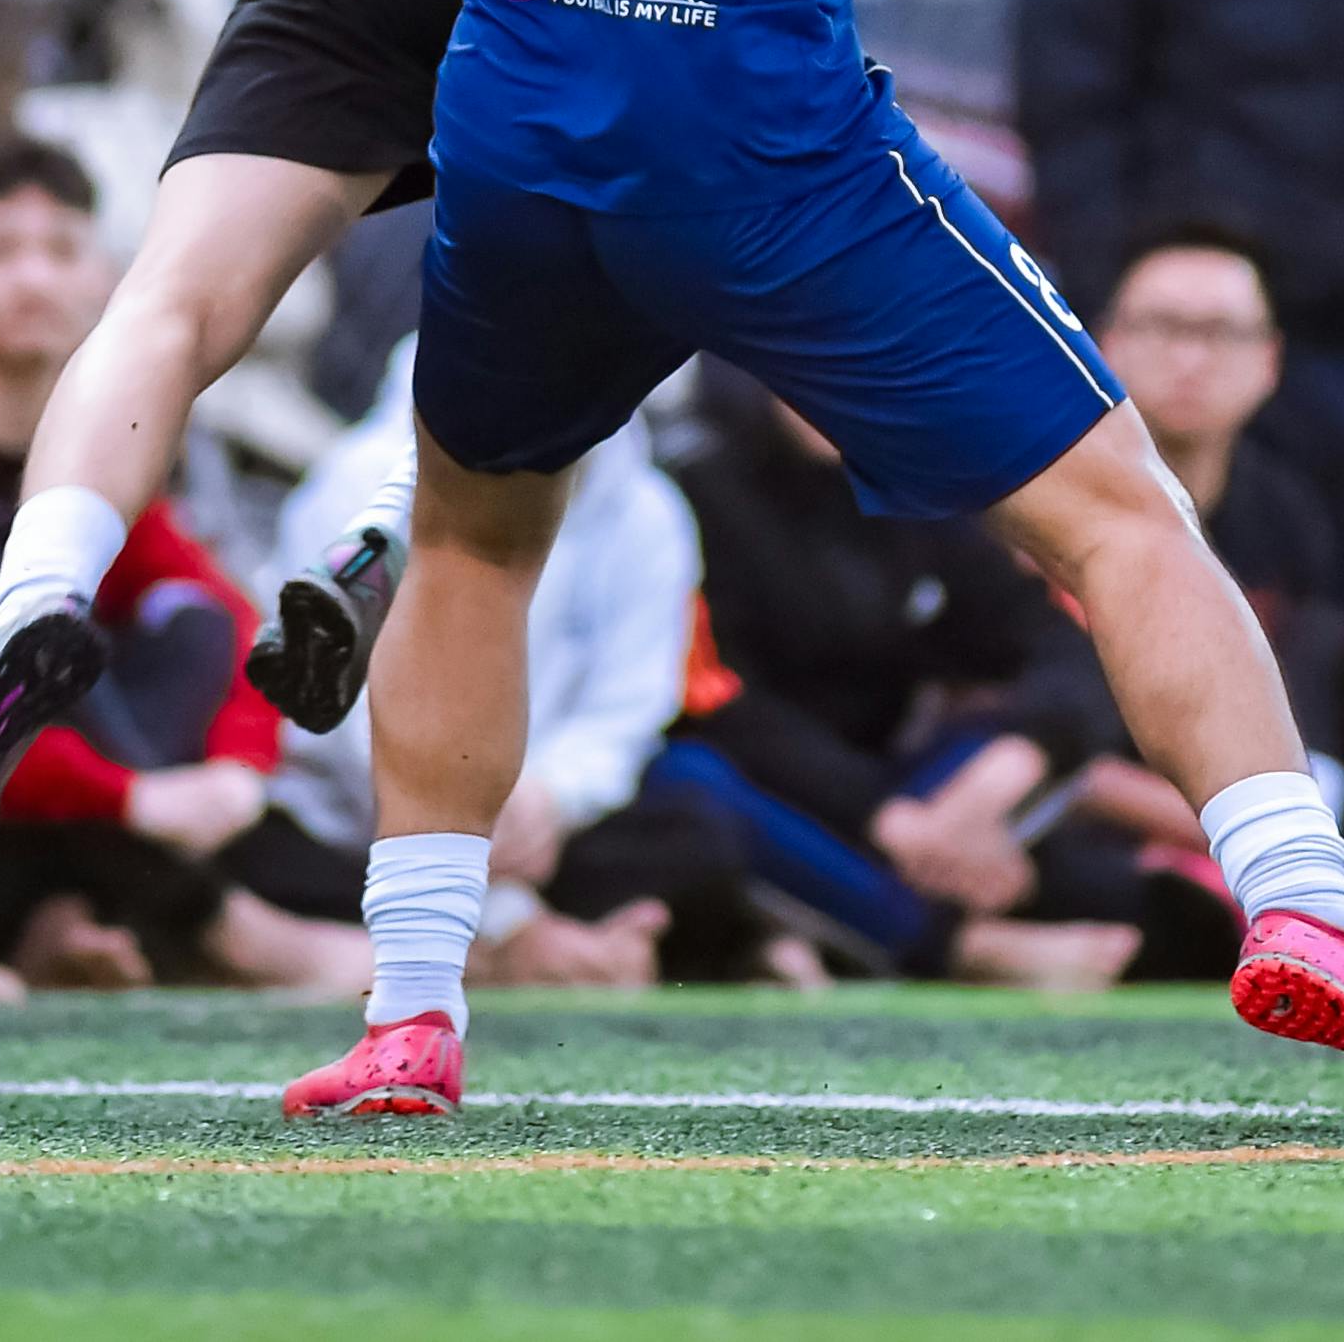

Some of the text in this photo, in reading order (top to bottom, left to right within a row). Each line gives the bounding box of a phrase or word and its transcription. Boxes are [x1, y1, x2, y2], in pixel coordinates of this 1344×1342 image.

[614, 0, 631, 18] IS
[634, 2, 668, 22] MY
[671, 6, 718, 28] LIFE
